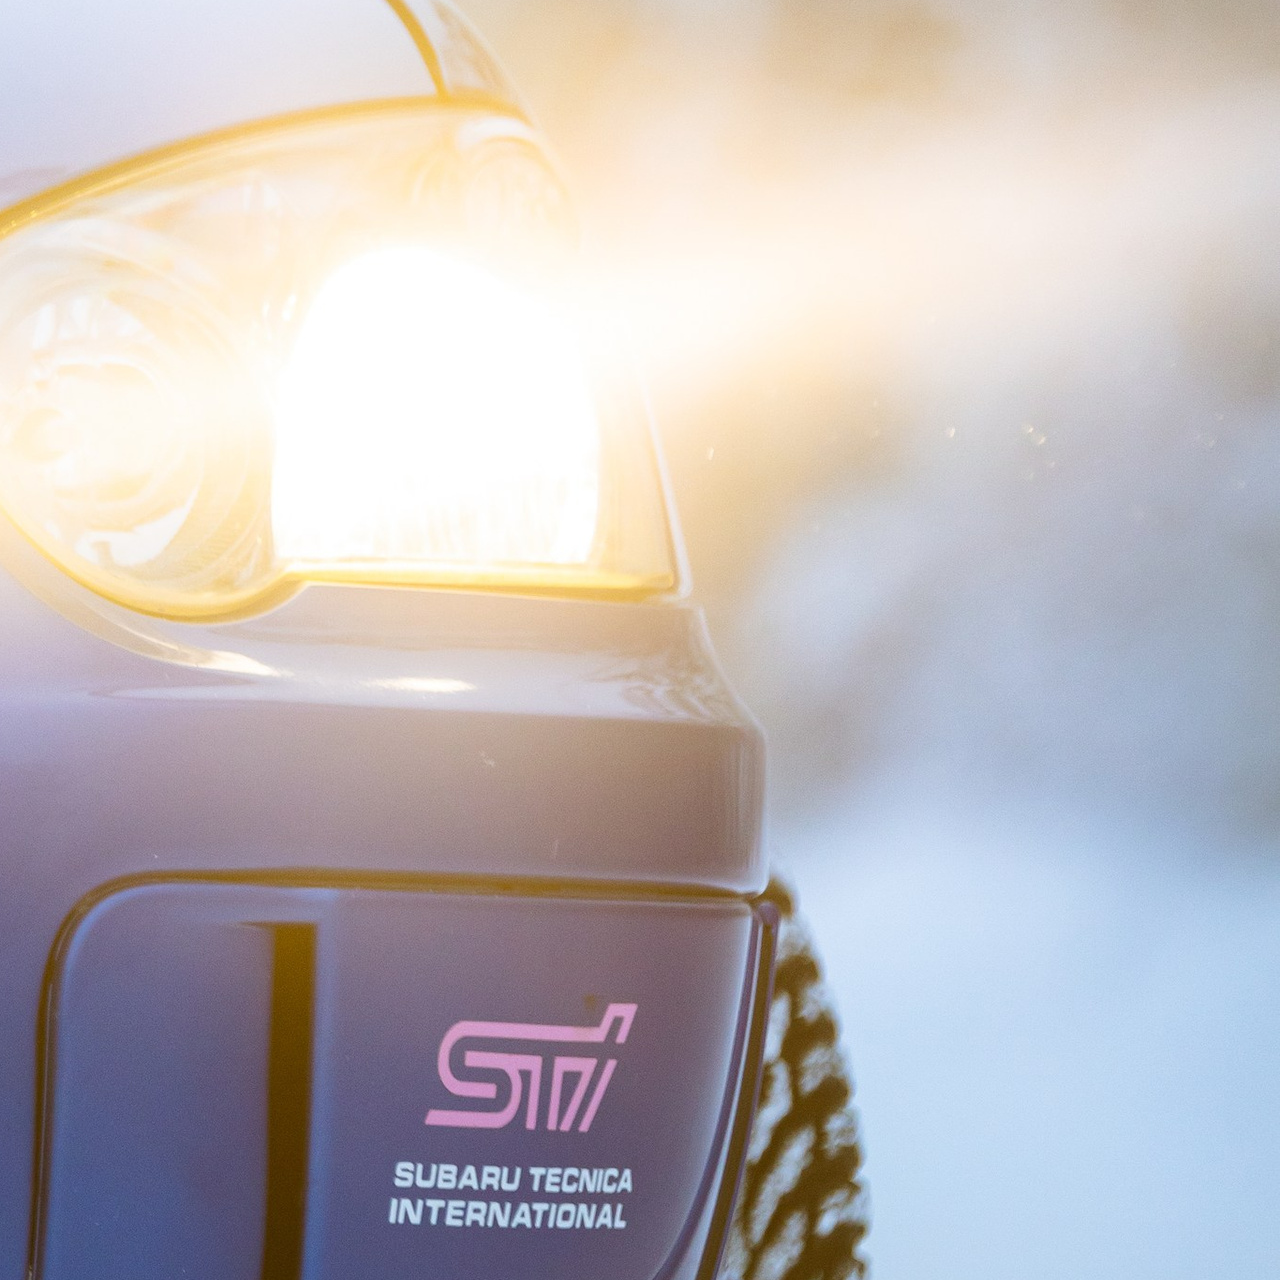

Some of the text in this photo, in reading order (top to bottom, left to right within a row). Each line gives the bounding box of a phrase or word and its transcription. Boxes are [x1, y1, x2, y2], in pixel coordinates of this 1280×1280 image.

[393, 1160, 634, 1194] SUBARU TECNICA
[387, 1197, 628, 1230] INTERNATIONAL
